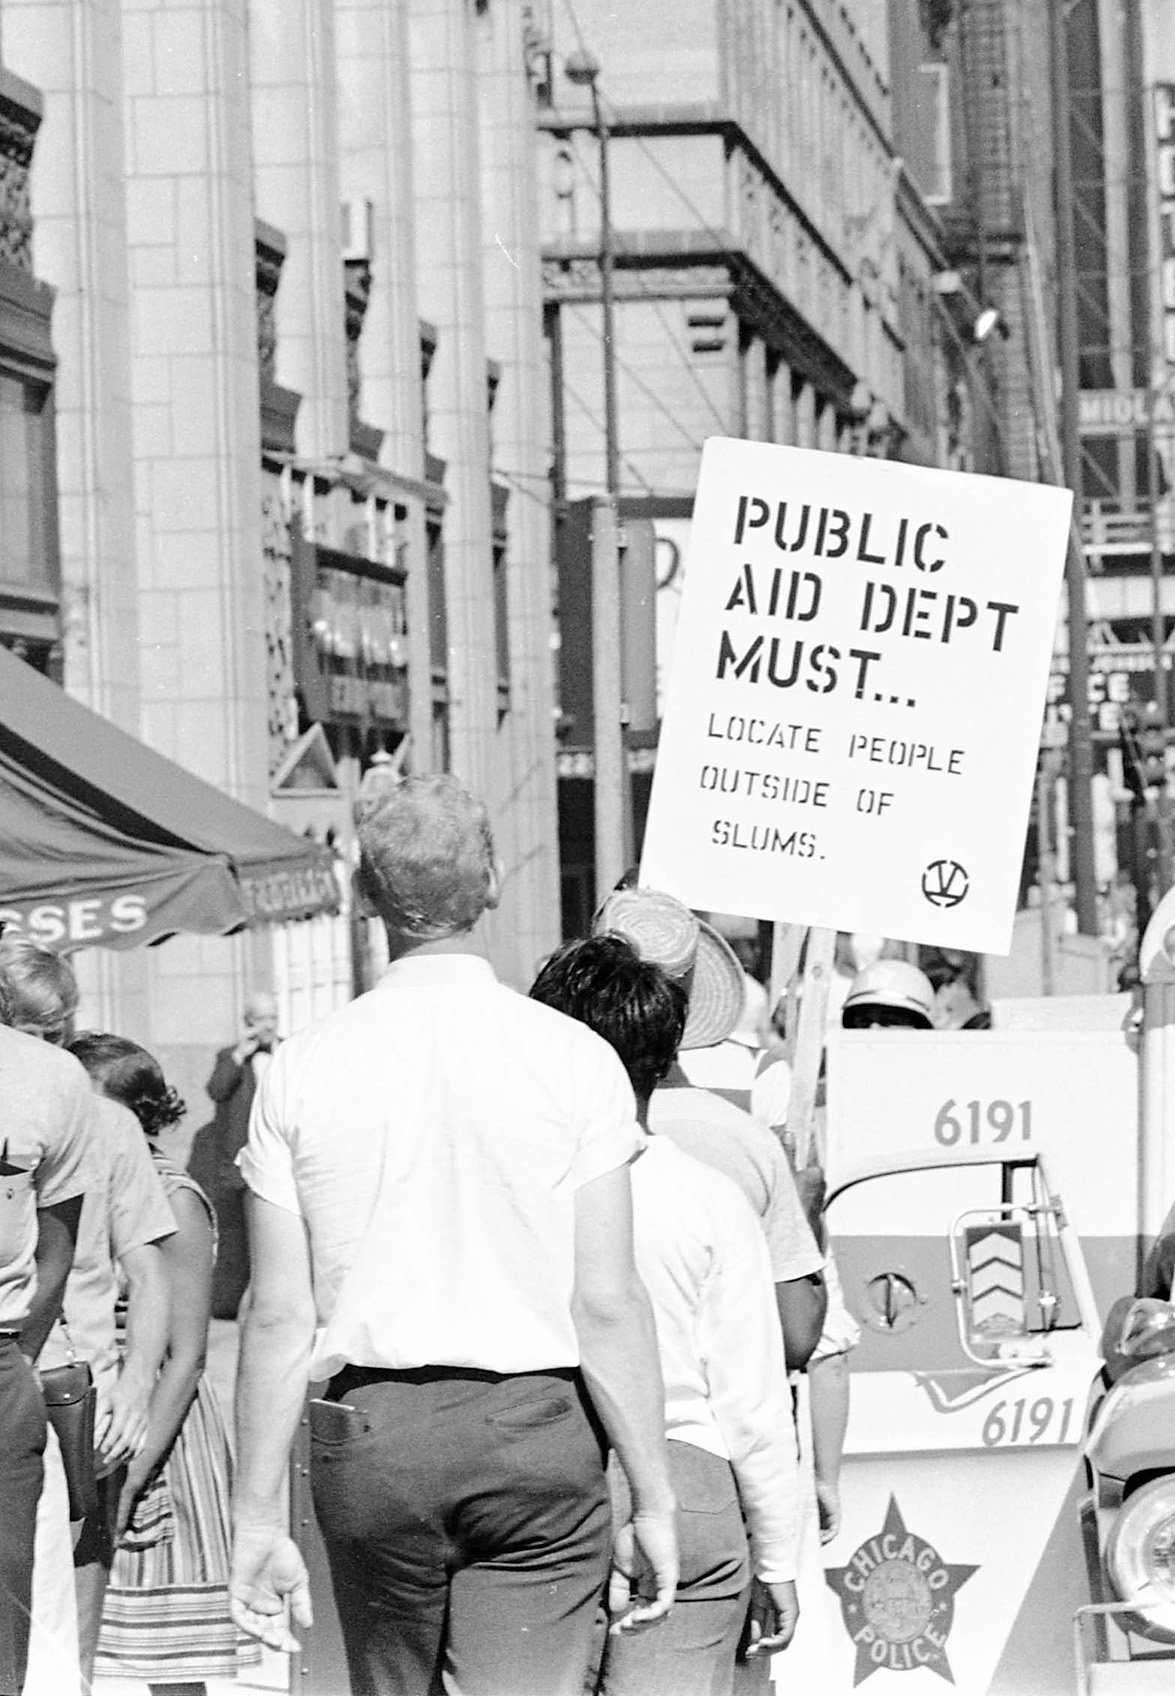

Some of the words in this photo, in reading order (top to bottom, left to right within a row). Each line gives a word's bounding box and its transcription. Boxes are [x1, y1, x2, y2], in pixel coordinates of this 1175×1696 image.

[734, 496, 948, 572] PUBLIC
[725, 564, 822, 622] AID
[860, 581, 1019, 652] DEPT
[716, 630, 915, 707] MUST...
[708, 713, 821, 753] LOCATE
[849, 735, 964, 774] PEOPLE
[701, 766, 829, 807] OUTSIDE
[857, 789, 894, 815] OF
[712, 820, 825, 859] SLUMS.
[934, 1099, 1033, 1146] 6191
[982, 1398, 1075, 1447] 6191
[843, 1533, 950, 1593] CHICAGO
[854, 1624, 948, 1669] POLICE
